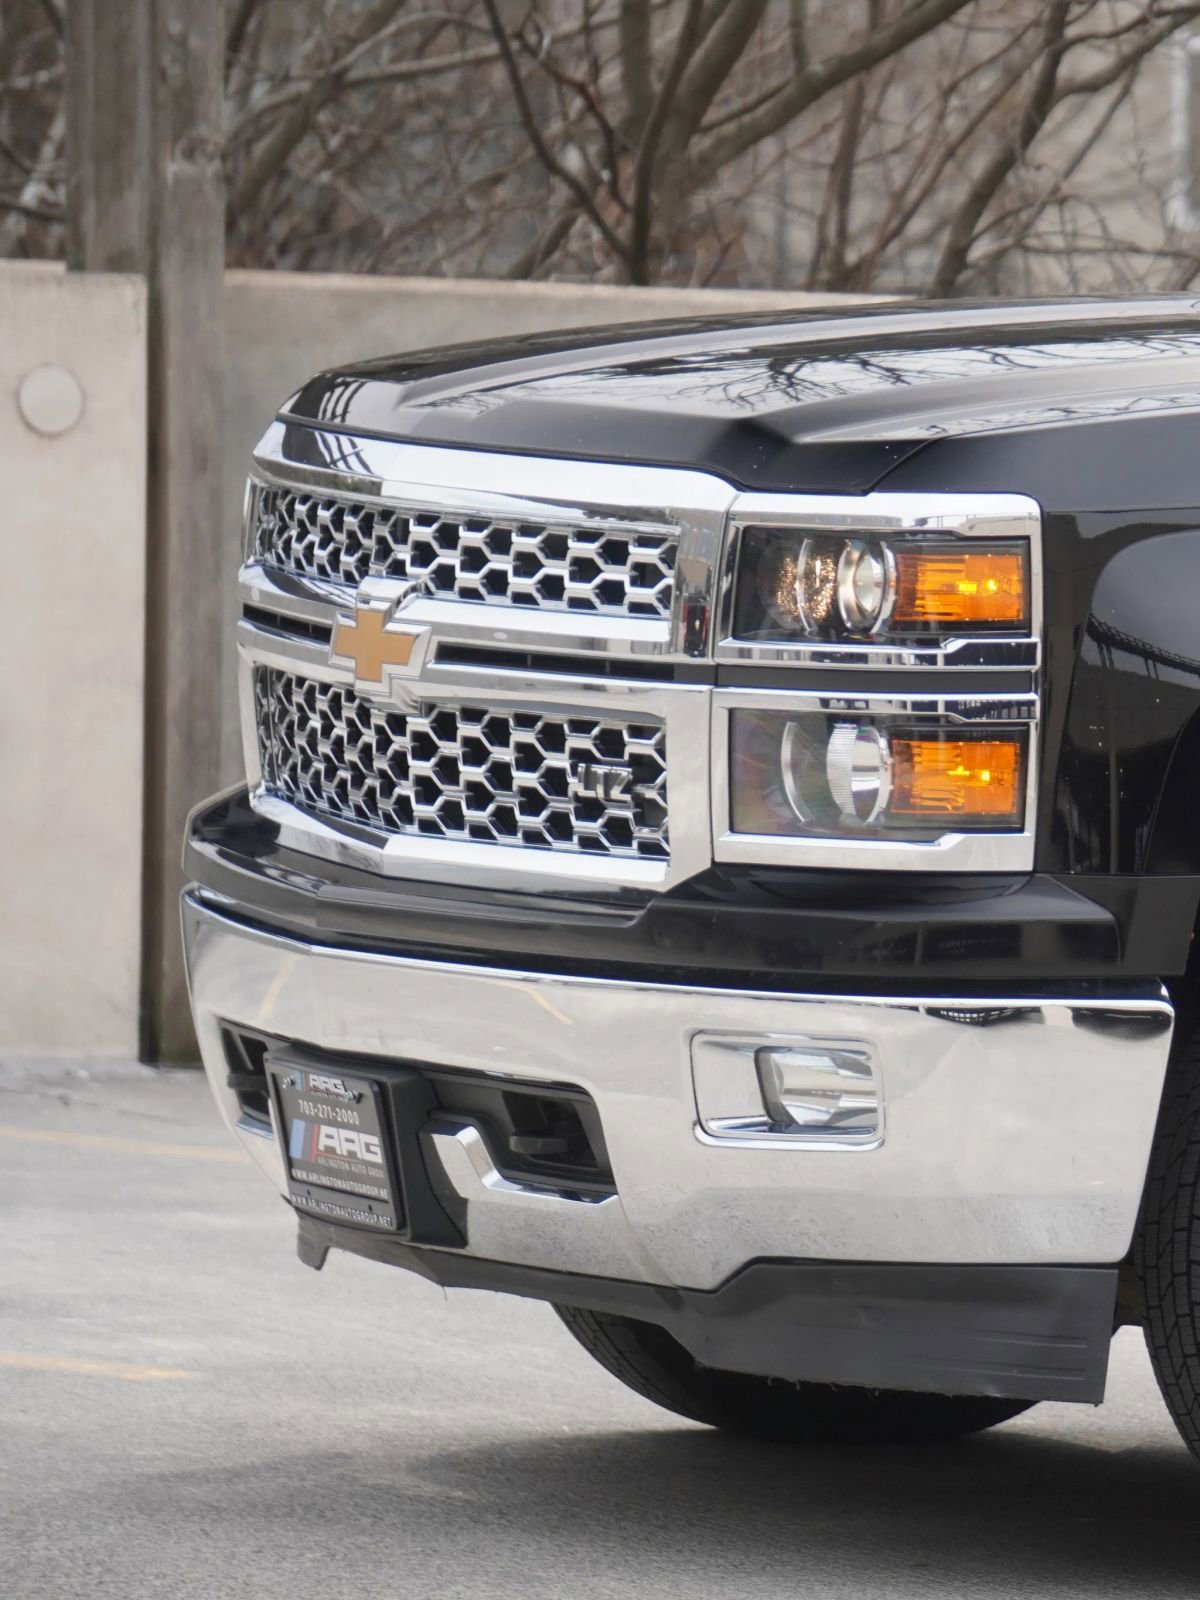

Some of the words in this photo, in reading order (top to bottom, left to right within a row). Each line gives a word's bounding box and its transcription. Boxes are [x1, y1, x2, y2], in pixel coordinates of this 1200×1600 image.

[577, 763, 633, 802] LTZ
[309, 1073, 348, 1094] AAG
[298, 1099, 360, 1125] 703-271-2000
[318, 1124, 384, 1164] AAG
[317, 1156, 350, 1171] ARLINGTON
[351, 1163, 367, 1175] AUTO
